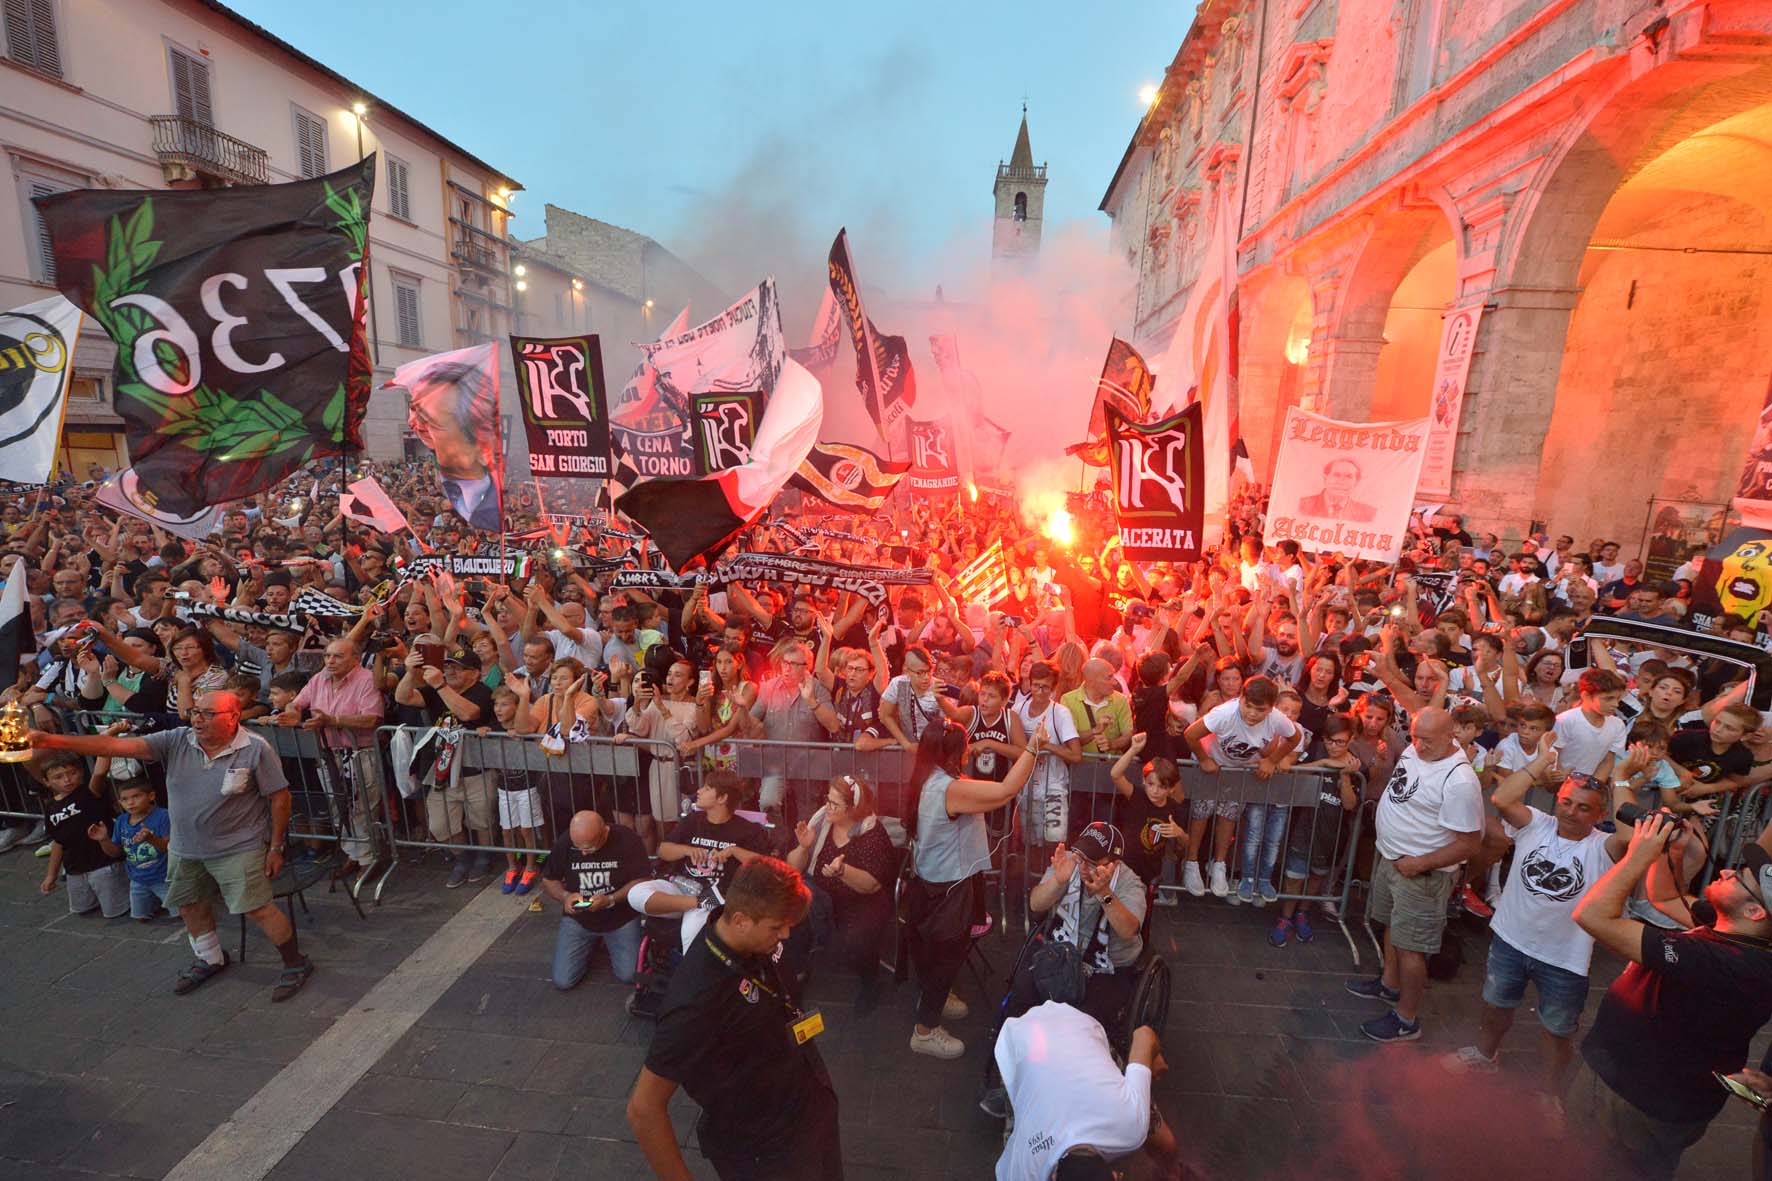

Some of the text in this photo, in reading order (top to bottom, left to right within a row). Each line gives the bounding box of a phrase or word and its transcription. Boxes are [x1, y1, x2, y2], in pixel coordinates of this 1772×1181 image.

[547, 430, 588, 447] PORTO
[636, 435, 673, 453] CENA
[1289, 417, 1421, 453] Leggenda
[530, 454, 607, 474] SAN GIORGIO
[639, 455, 691, 475] TORNO
[1272, 516, 1394, 552] Ascolana
[571, 862, 580, 870] LA
[601, 861, 618, 869] COME
[579, 871, 610, 889] NOI
